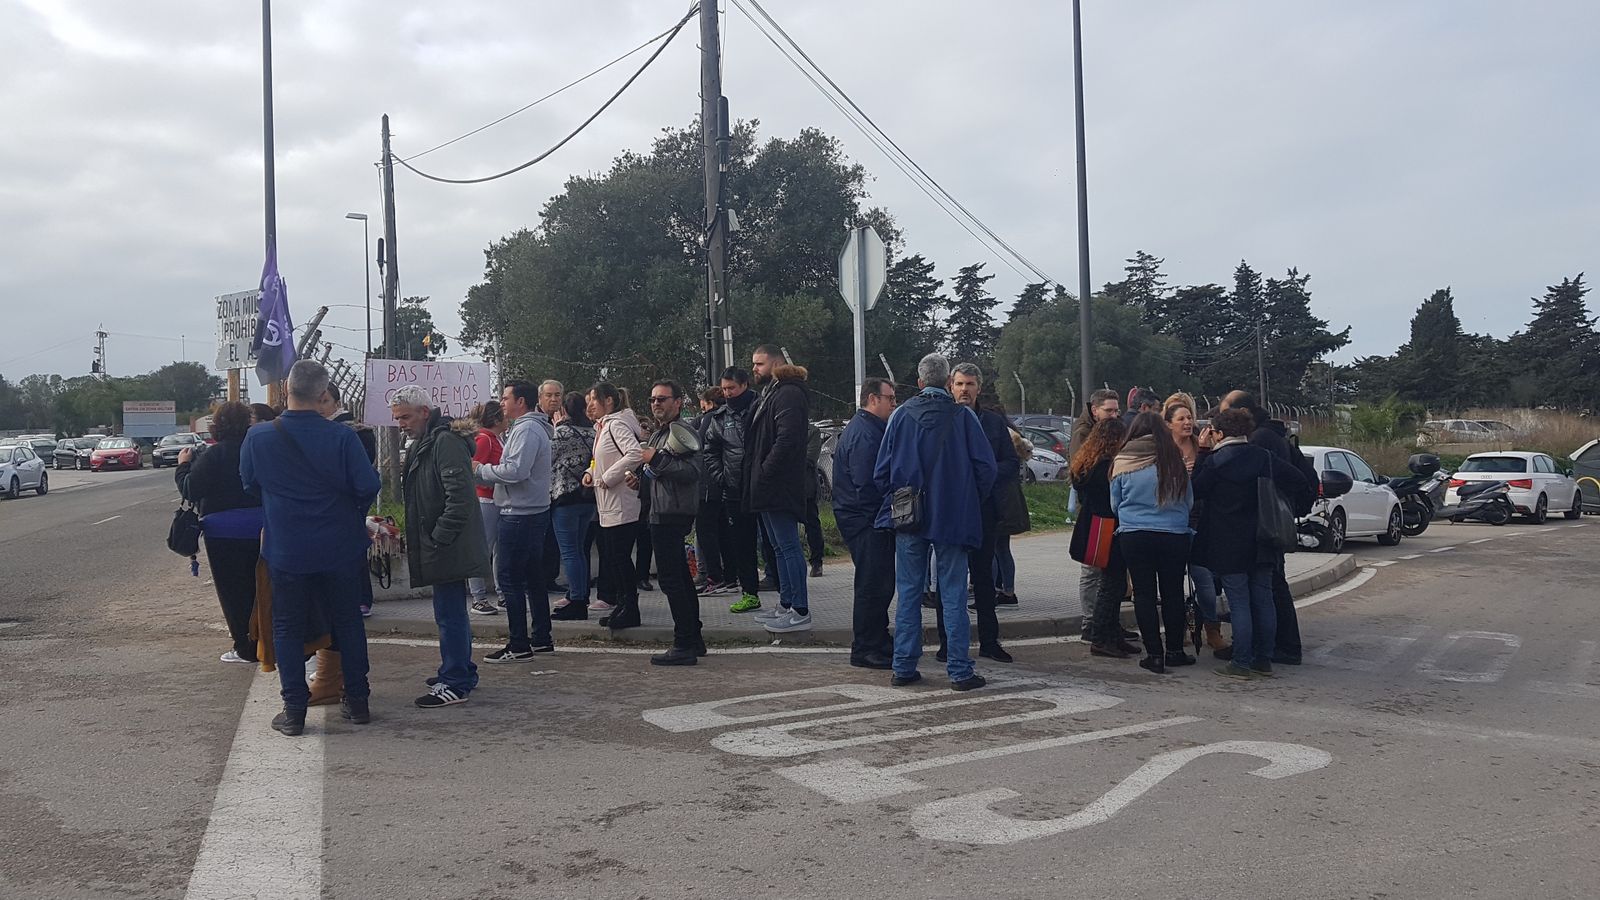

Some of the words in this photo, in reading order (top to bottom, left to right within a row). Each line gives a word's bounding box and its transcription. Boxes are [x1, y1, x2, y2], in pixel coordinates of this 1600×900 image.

[217, 298, 240, 319] ZONA
[224, 318, 257, 341] PROHIB
[229, 344, 240, 362] EL
[387, 364, 443, 383] BASTA
[457, 364, 476, 382] YA
